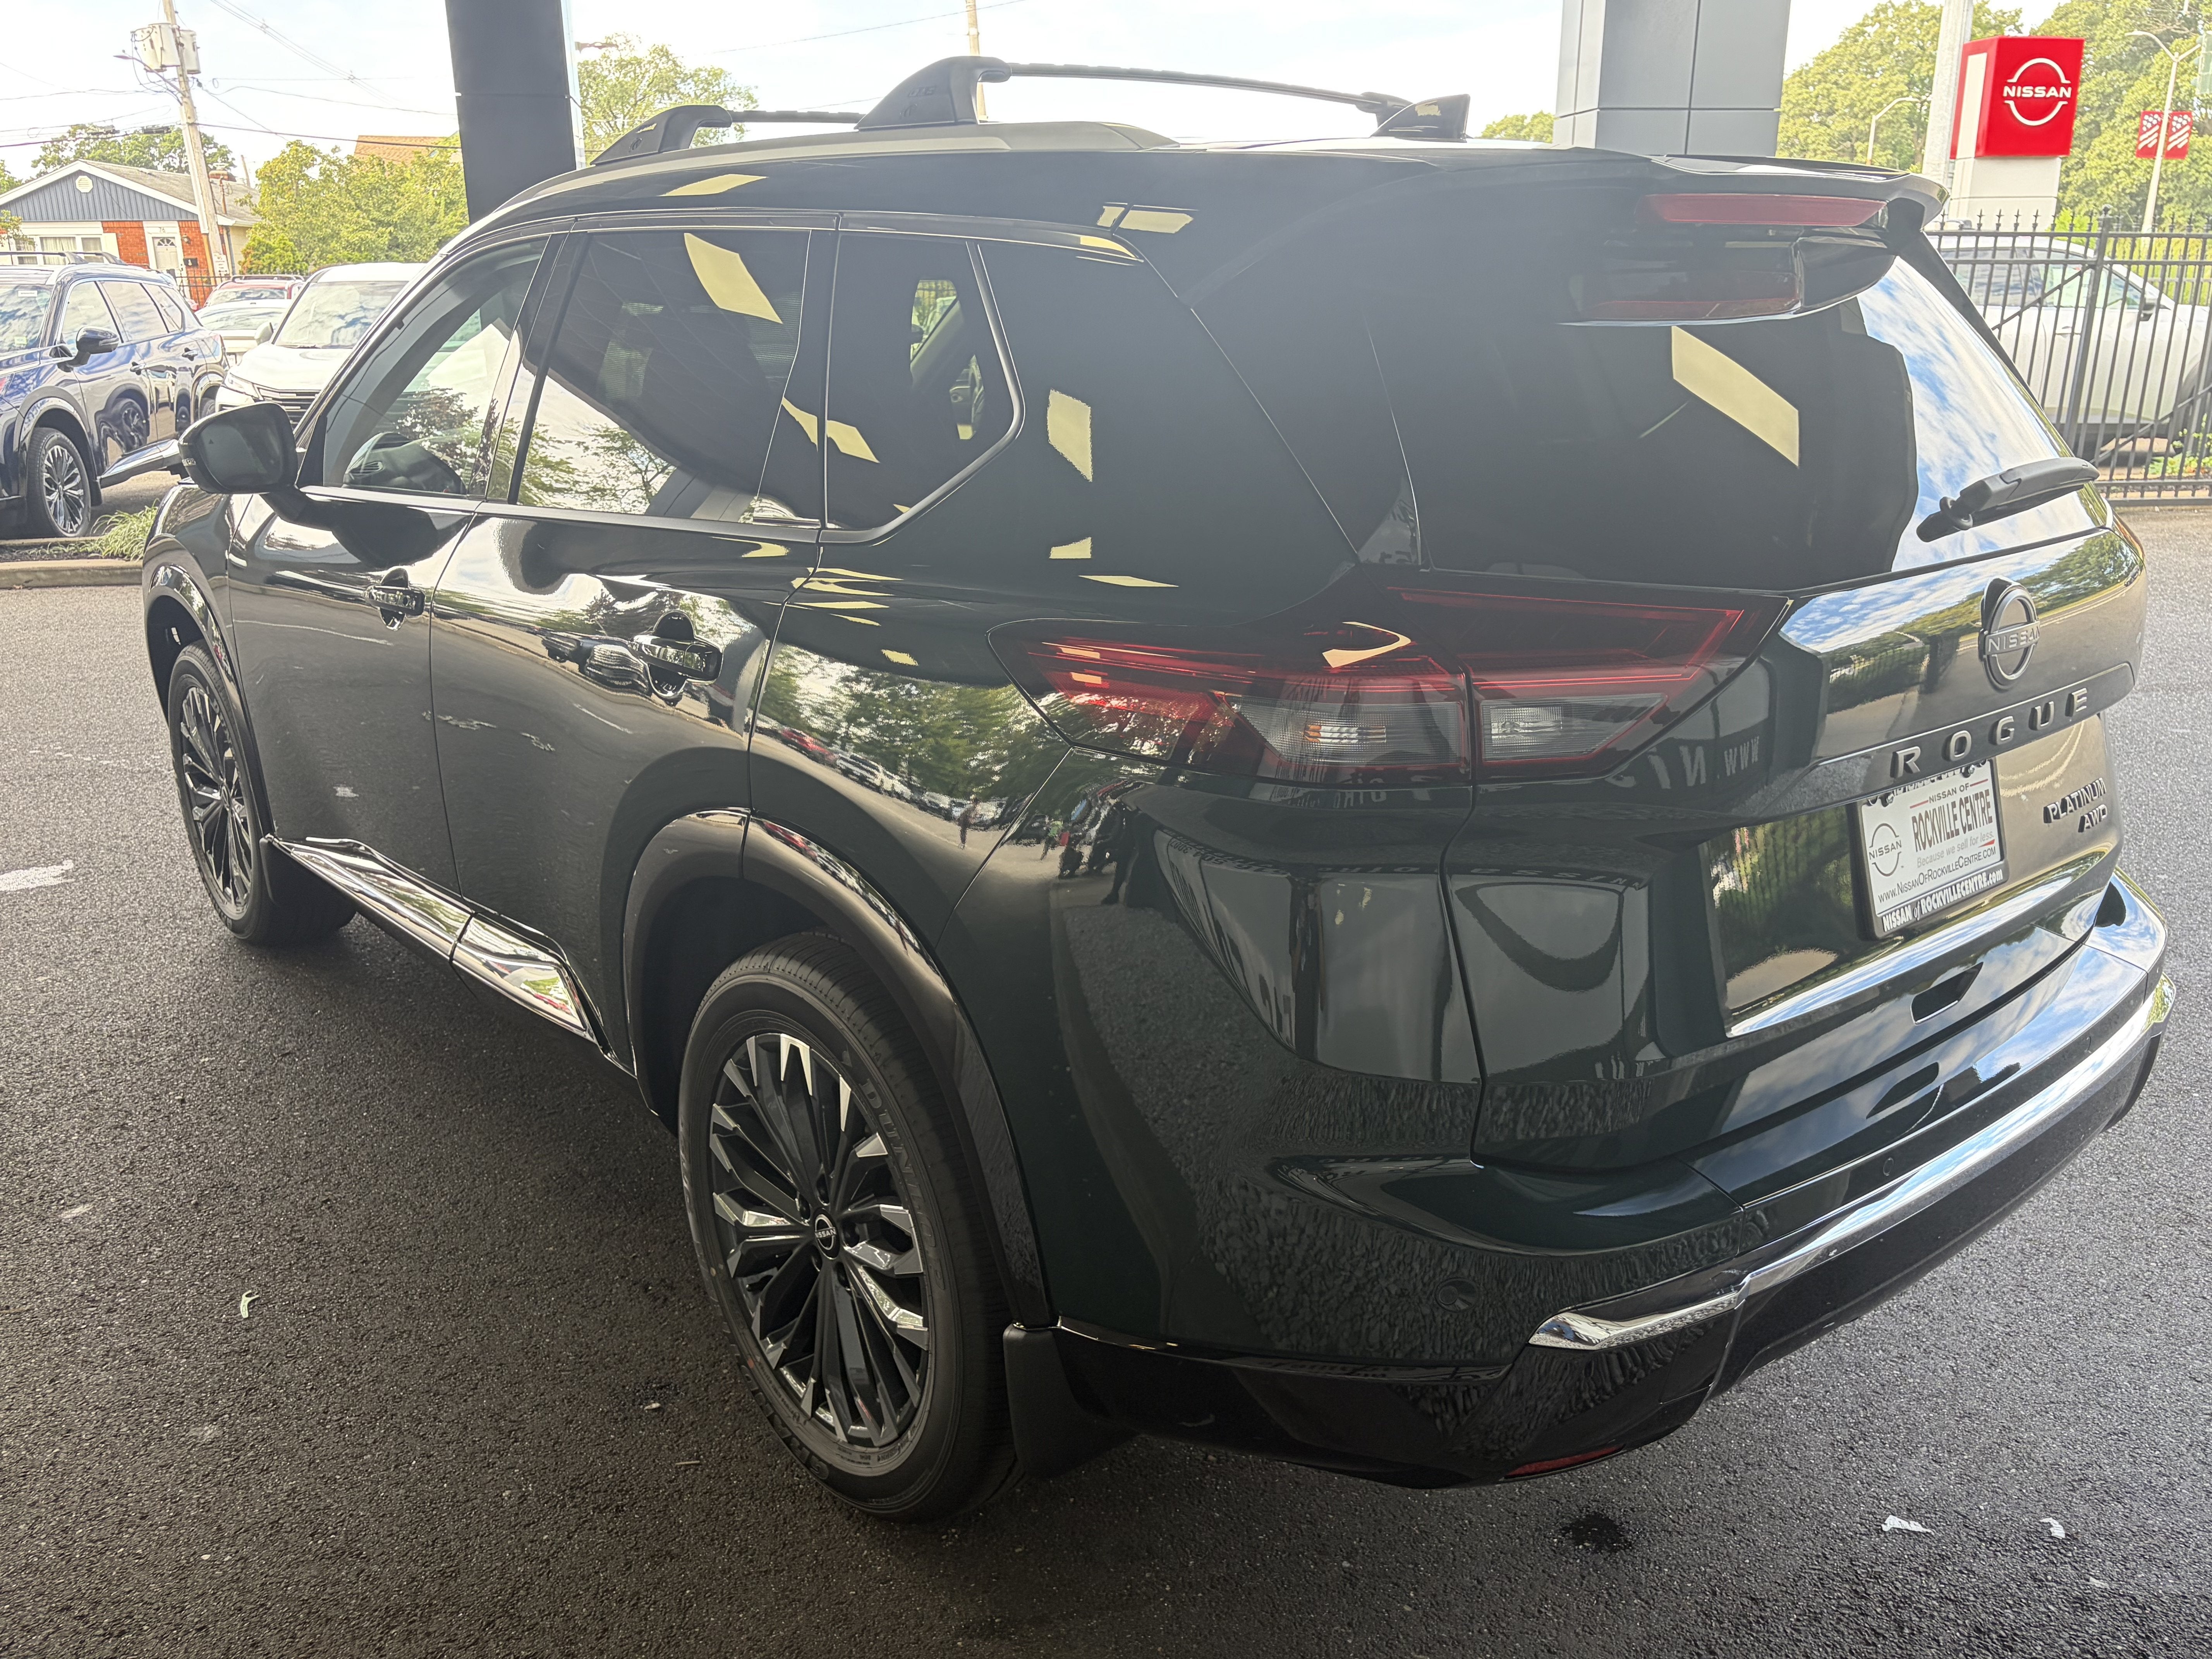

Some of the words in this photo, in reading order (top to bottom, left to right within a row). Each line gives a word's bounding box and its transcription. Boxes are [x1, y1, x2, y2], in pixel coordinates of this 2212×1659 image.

[2003, 86, 2072, 98] NISSAN
[1988, 626, 2040, 653] NISSAN
[1892, 688, 2087, 778] ROGUE
[1929, 787, 1956, 803] NISSAN
[1959, 783, 1969, 792] OF
[2044, 777, 2107, 823] PLATINUM
[1911, 801, 1960, 852] ROCKVILLE
[1959, 789, 1993, 834] CENTRE
[2078, 804, 2107, 832] AWD
[1869, 840, 1902, 860] NISSAN
[1917, 850, 1944, 868] Because
[1946, 847, 1955, 856] we
[1957, 838, 1968, 852] sell
[1970, 836, 1978, 847] for
[1980, 831, 1994, 842] less.
[1882, 905, 1912, 932] NISSAN
[1913, 901, 1921, 921] of
[1921, 869, 2003, 915] ROCKVILLECENTRE.com
[859, 1078, 945, 1290] DUNLOP
